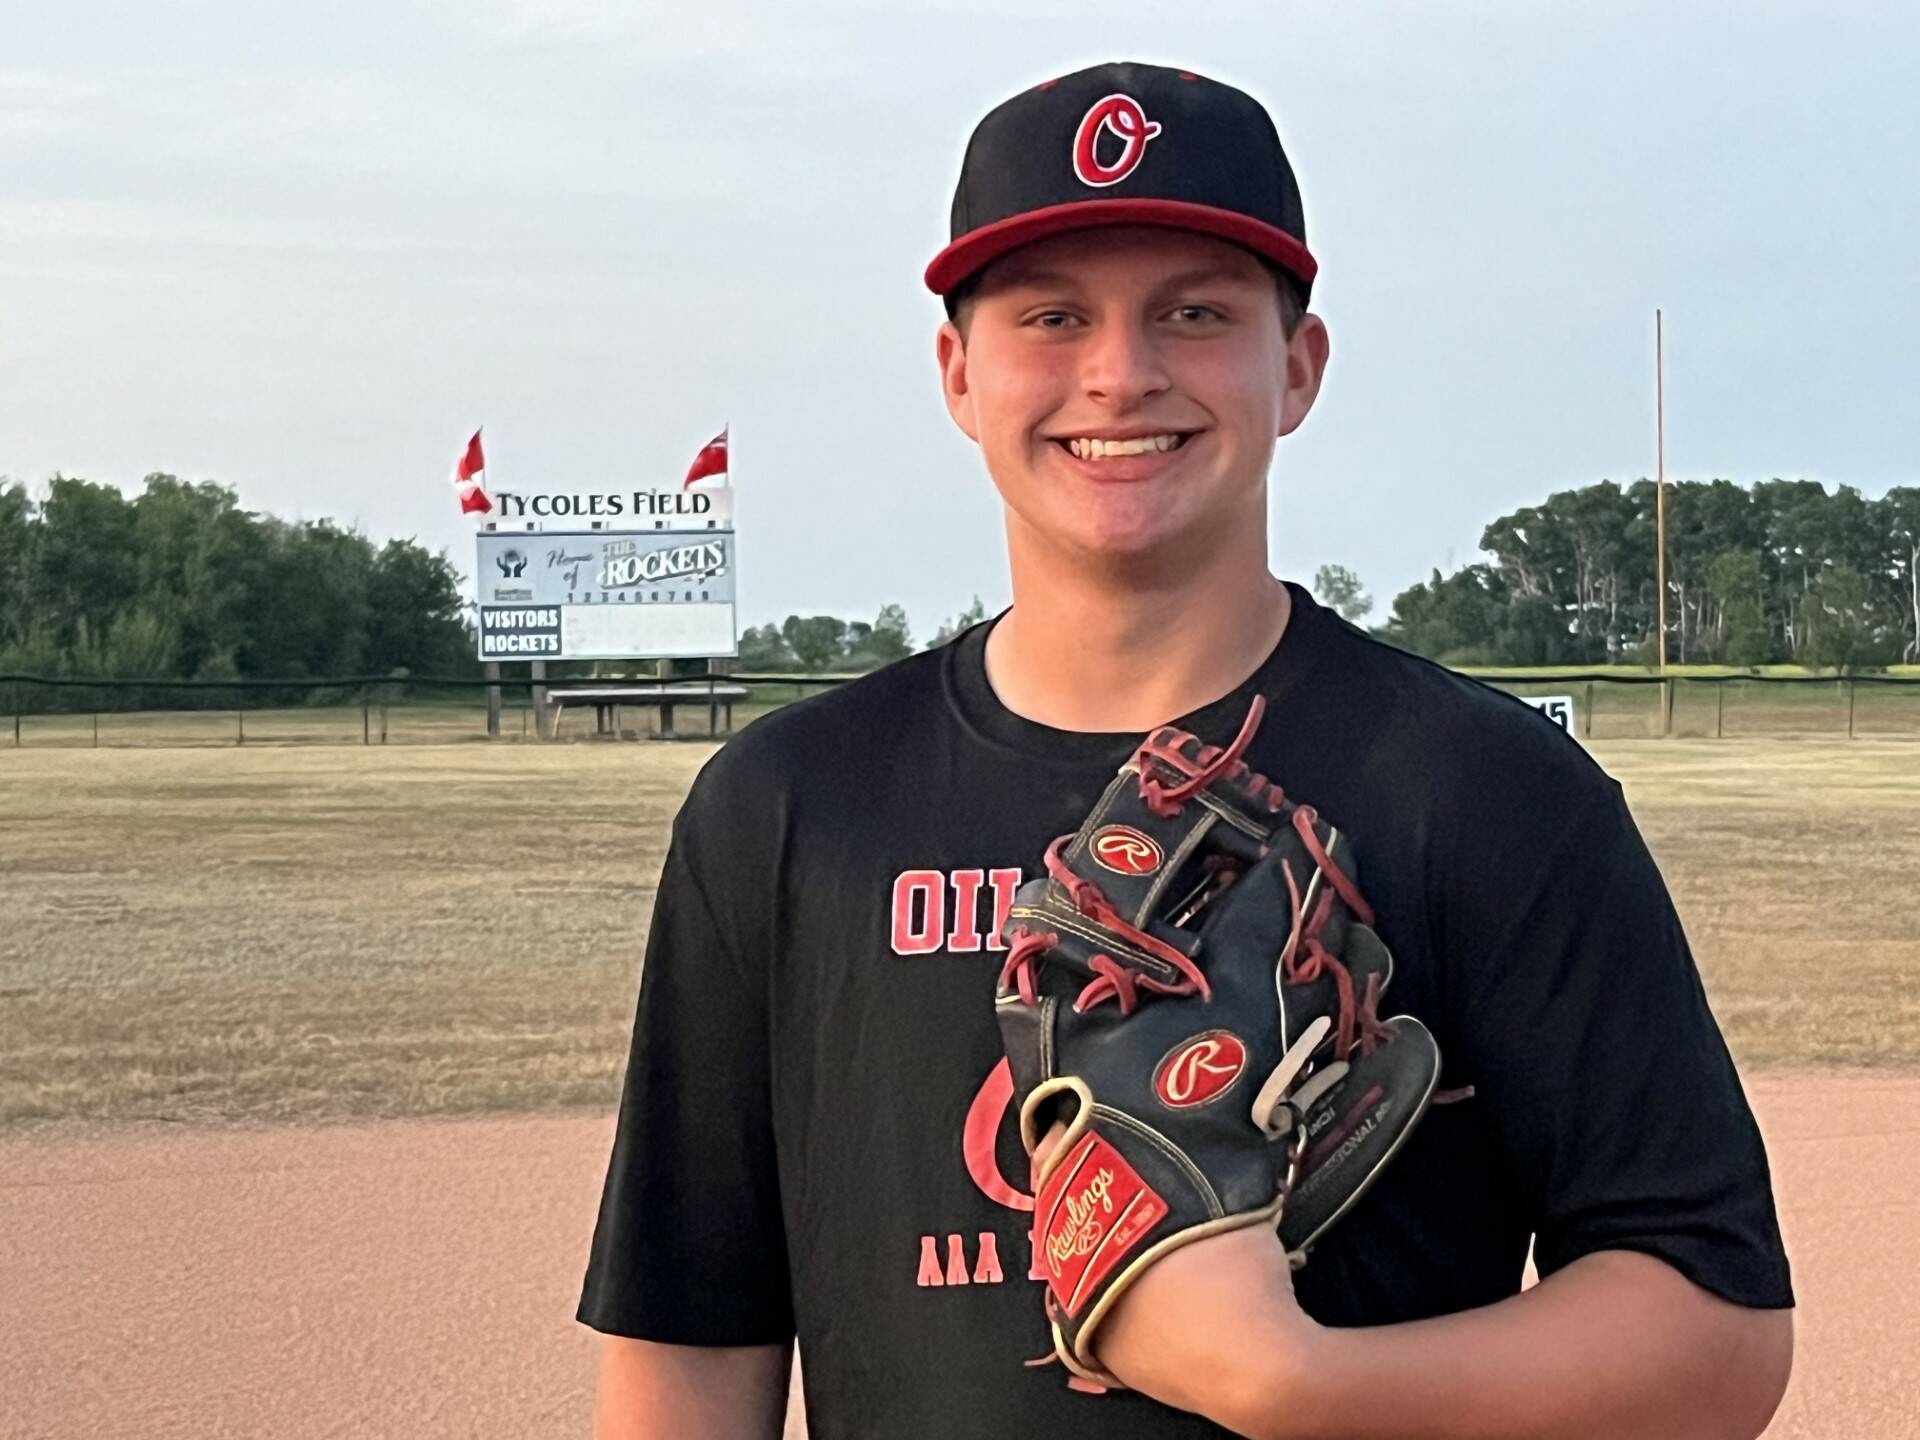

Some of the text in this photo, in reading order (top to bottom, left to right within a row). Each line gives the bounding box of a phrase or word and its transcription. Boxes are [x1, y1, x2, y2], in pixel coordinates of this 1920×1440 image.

[1073, 93, 1162, 187] O
[606, 540, 723, 586] ROCKETS
[484, 610, 558, 628] VISITORS
[485, 634, 558, 652] ROCKETS
[1046, 1167, 1114, 1278] Rawlings
[917, 1232, 1004, 1286] AAA
